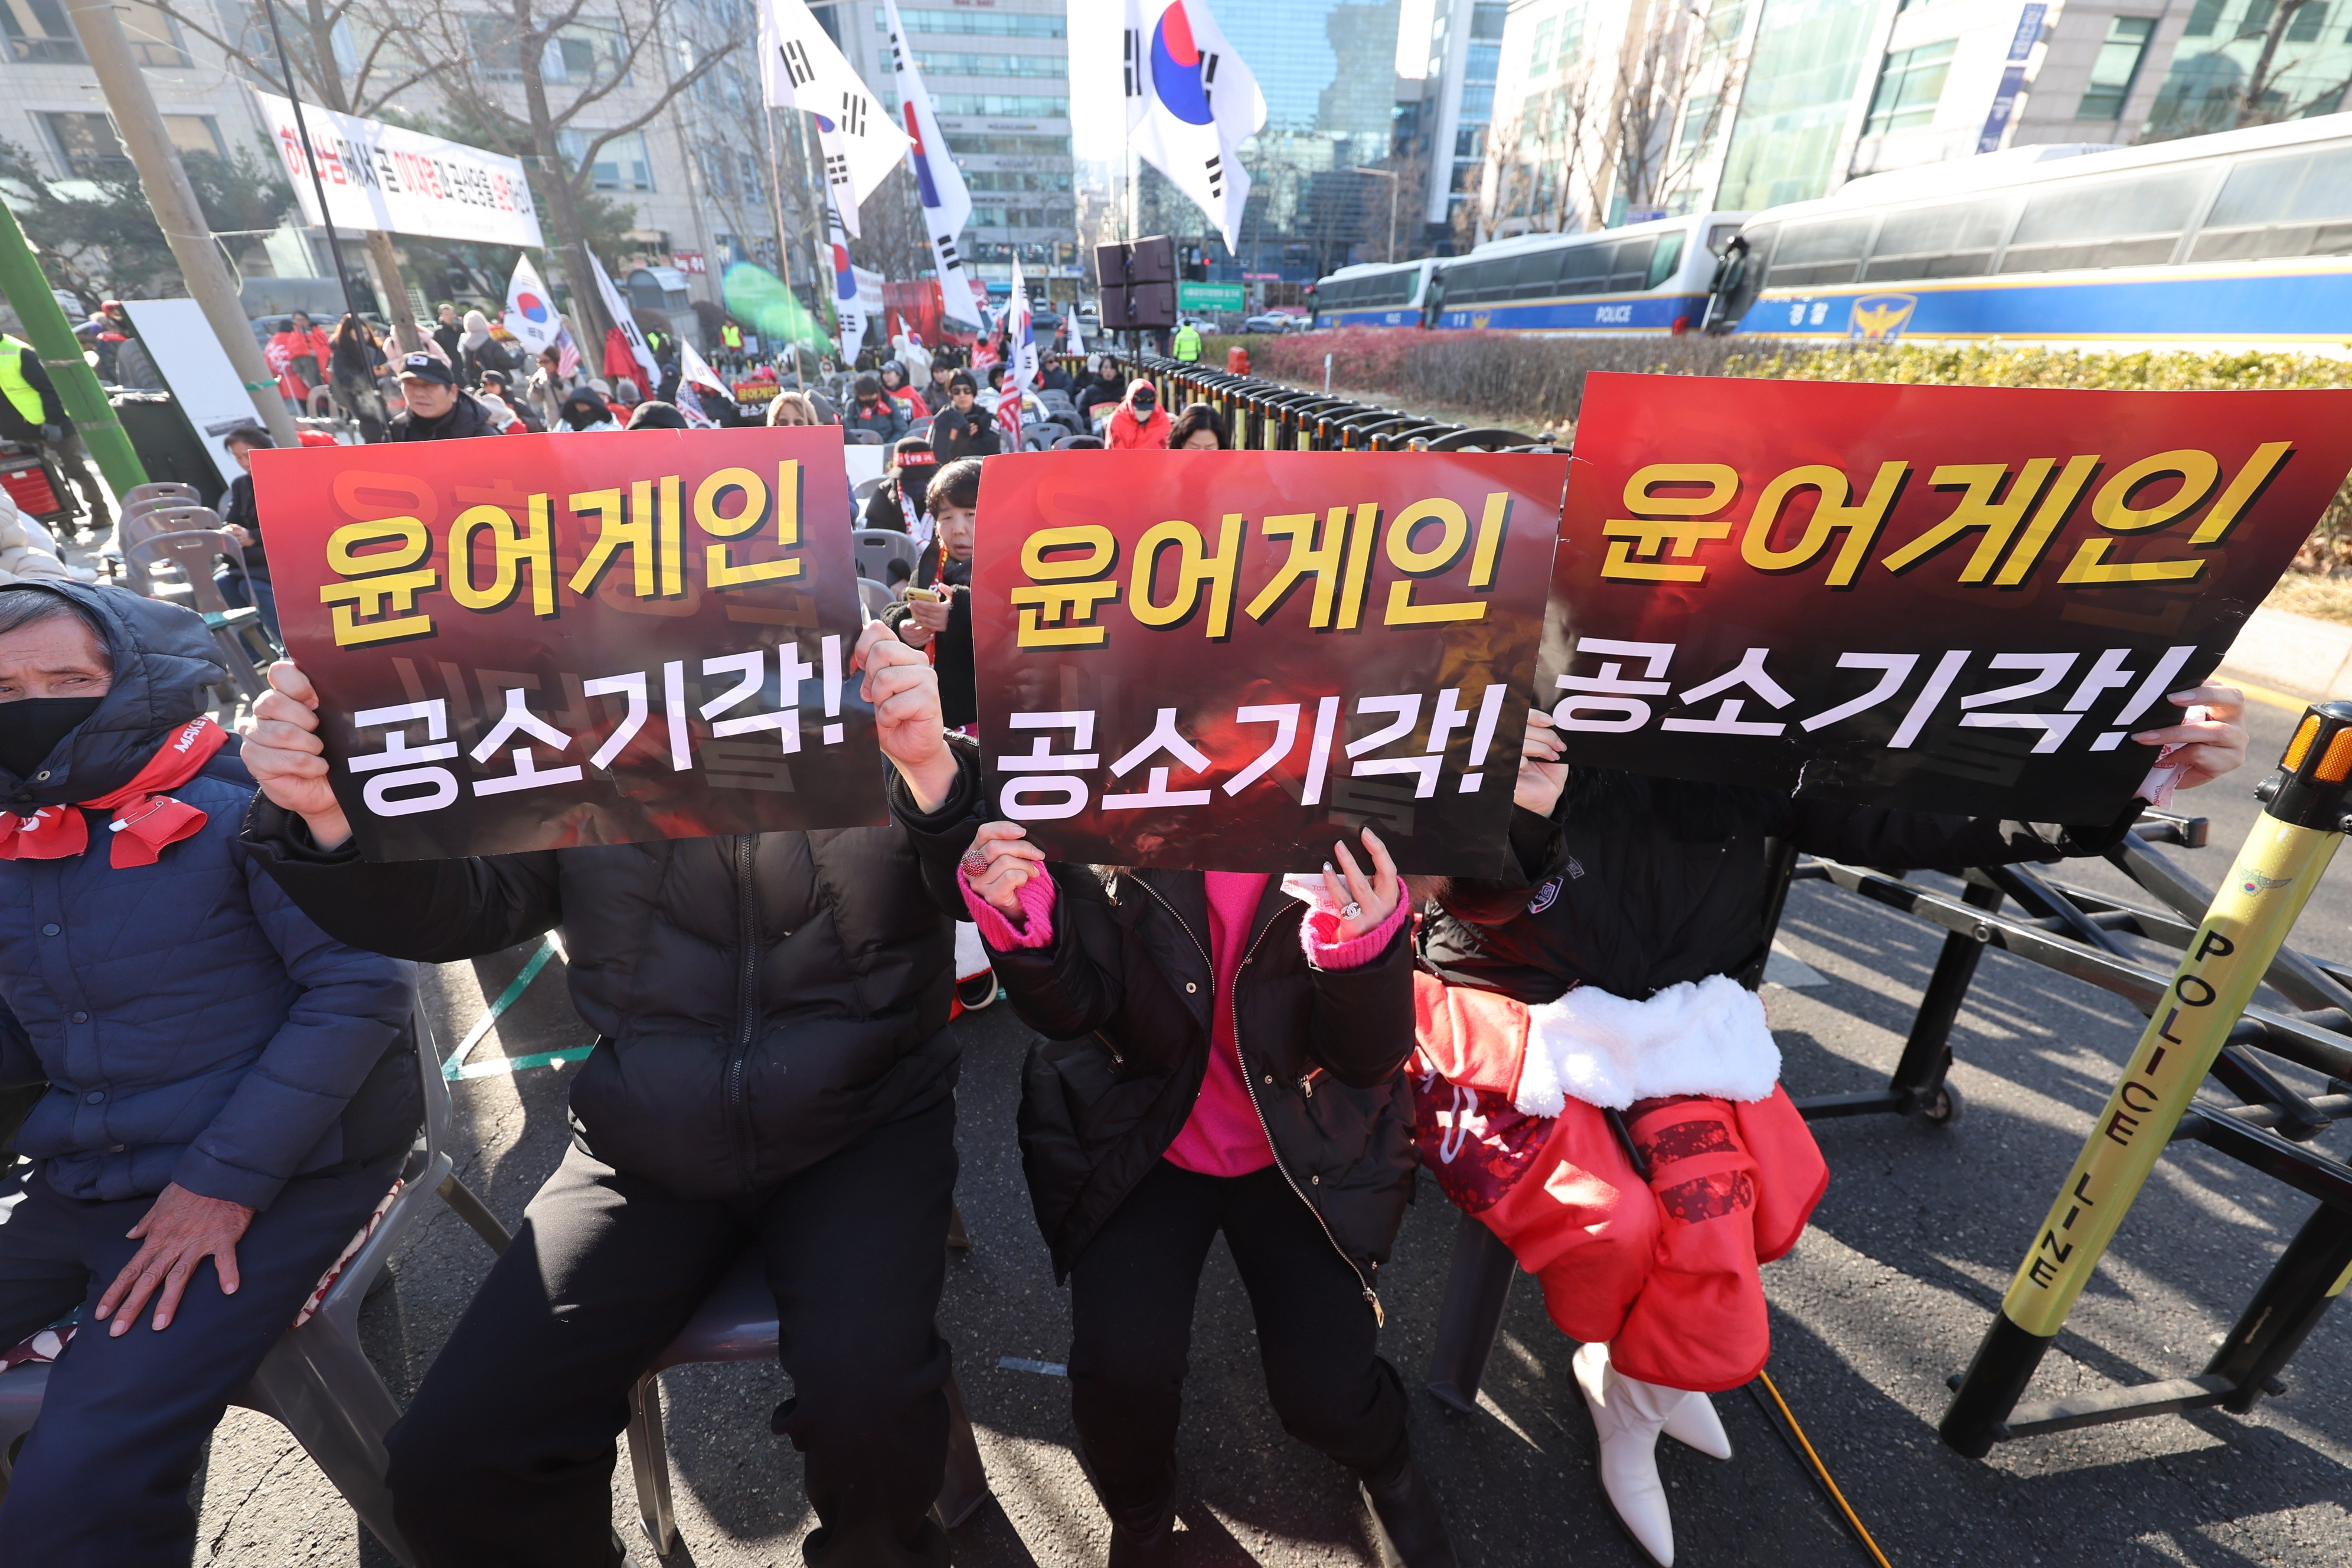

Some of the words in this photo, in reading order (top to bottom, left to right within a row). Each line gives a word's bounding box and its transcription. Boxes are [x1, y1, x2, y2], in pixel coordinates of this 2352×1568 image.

[1595, 305, 1631, 324] POLICE
[737, 385, 779, 401] 윤어게인
[739, 402, 769, 417] 공소기
[320, 459, 800, 647] 윤어게인
[1011, 491, 1509, 647] 윤어게인
[1600, 440, 2293, 586] 윤어게인
[173, 718, 207, 754] MAKE
[347, 634, 844, 818] 공소기각!
[997, 683, 1508, 821] 공소기각!
[1552, 636, 2199, 754] 공소기각!
[2104, 929, 2235, 1146] POLICE
[2028, 1172, 2094, 1289] LINE
